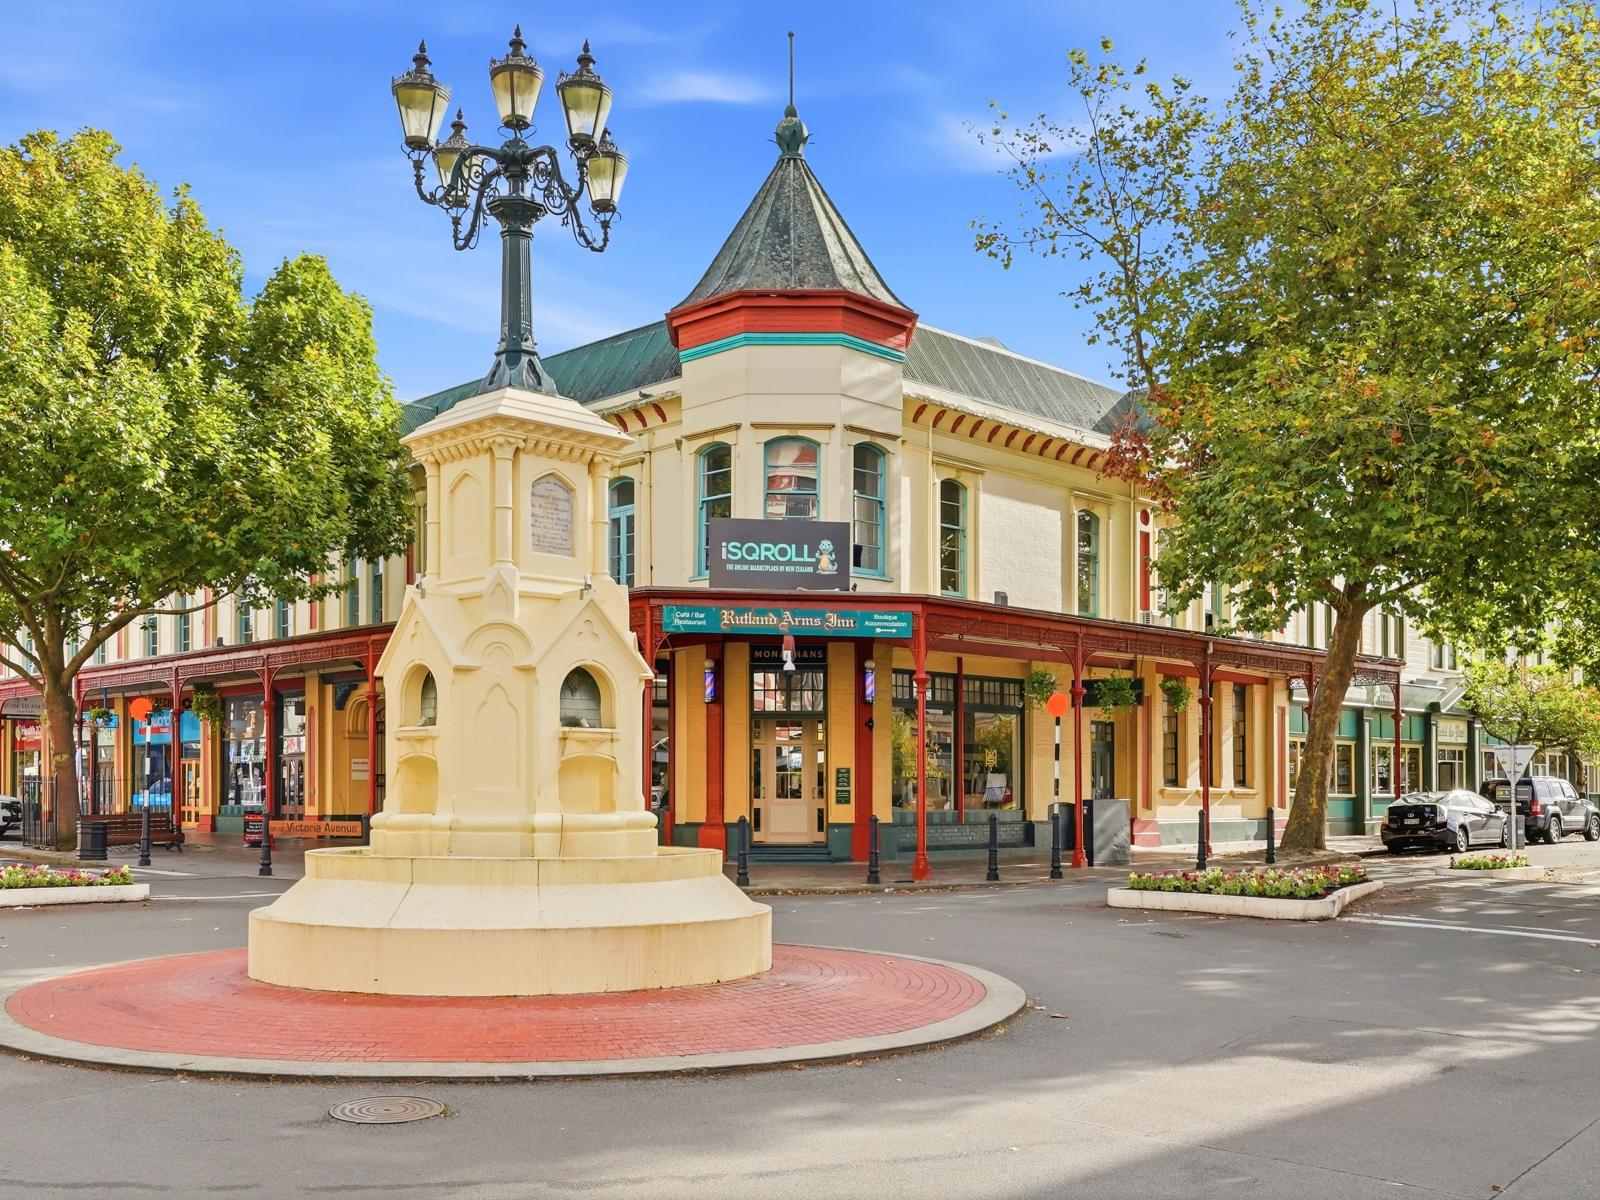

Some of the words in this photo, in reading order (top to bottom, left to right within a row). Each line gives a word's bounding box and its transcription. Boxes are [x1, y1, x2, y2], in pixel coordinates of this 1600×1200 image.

[721, 541, 816, 562] iSQROLL
[750, 564, 779, 572] MARKETPLACE
[720, 609, 777, 629] Rutland
[779, 611, 821, 630] Arms
[824, 612, 855, 631] Inn
[873, 613, 898, 621] Boutique
[286, 822, 322, 833] Victoria
[324, 822, 358, 833] Avenue
